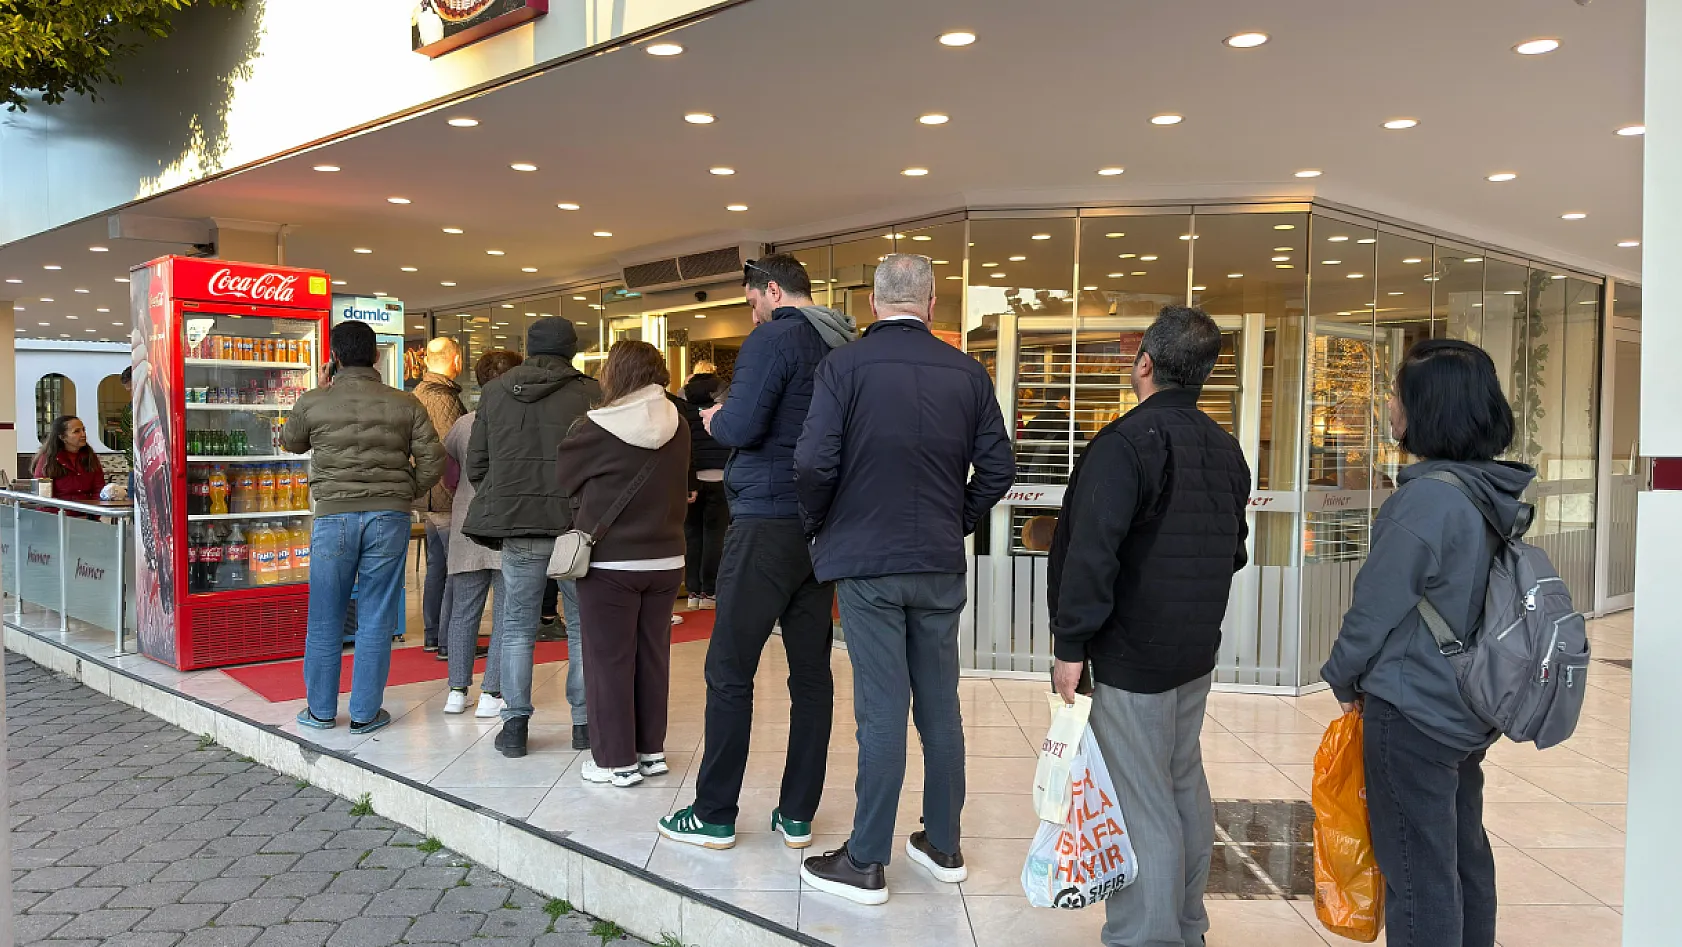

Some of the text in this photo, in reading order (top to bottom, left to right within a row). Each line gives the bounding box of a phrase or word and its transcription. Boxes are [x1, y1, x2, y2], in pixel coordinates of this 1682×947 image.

[208, 268, 299, 302] Coca-Cola
[343, 306, 389, 322] damla
[75, 557, 105, 580] hüner
[1090, 873, 1125, 896] SIFIR
